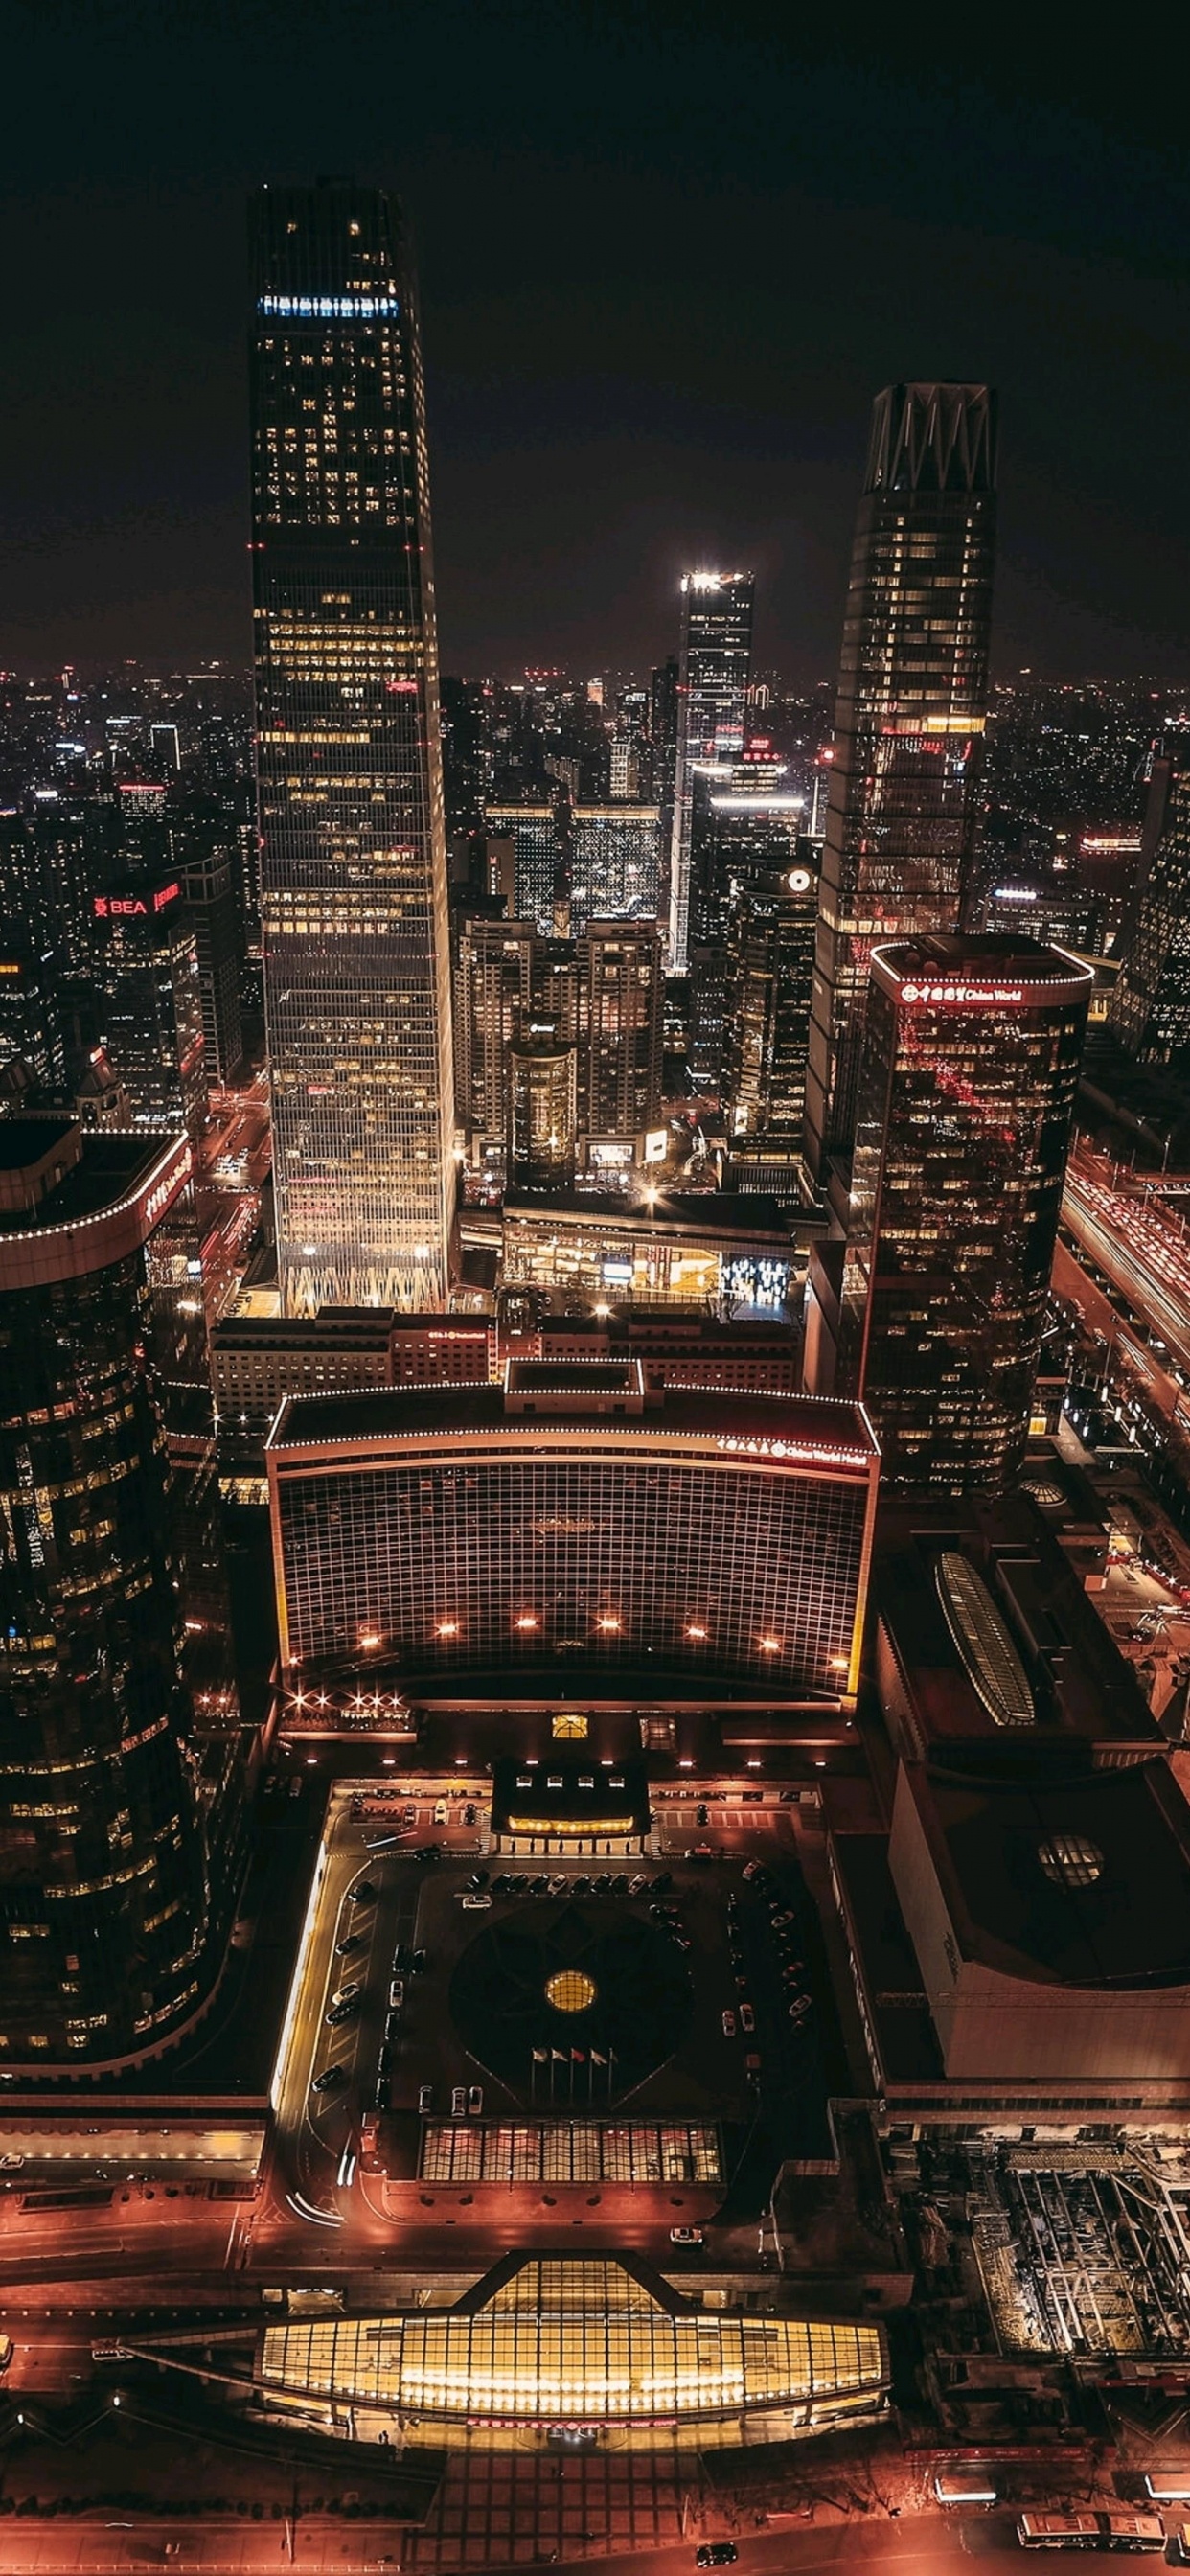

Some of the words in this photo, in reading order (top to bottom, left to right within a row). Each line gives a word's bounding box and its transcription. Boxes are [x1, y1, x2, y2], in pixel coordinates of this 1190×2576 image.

[110, 900, 147, 914] BEA
[965, 988, 994, 1001] China
[994, 989, 1022, 1001] World
